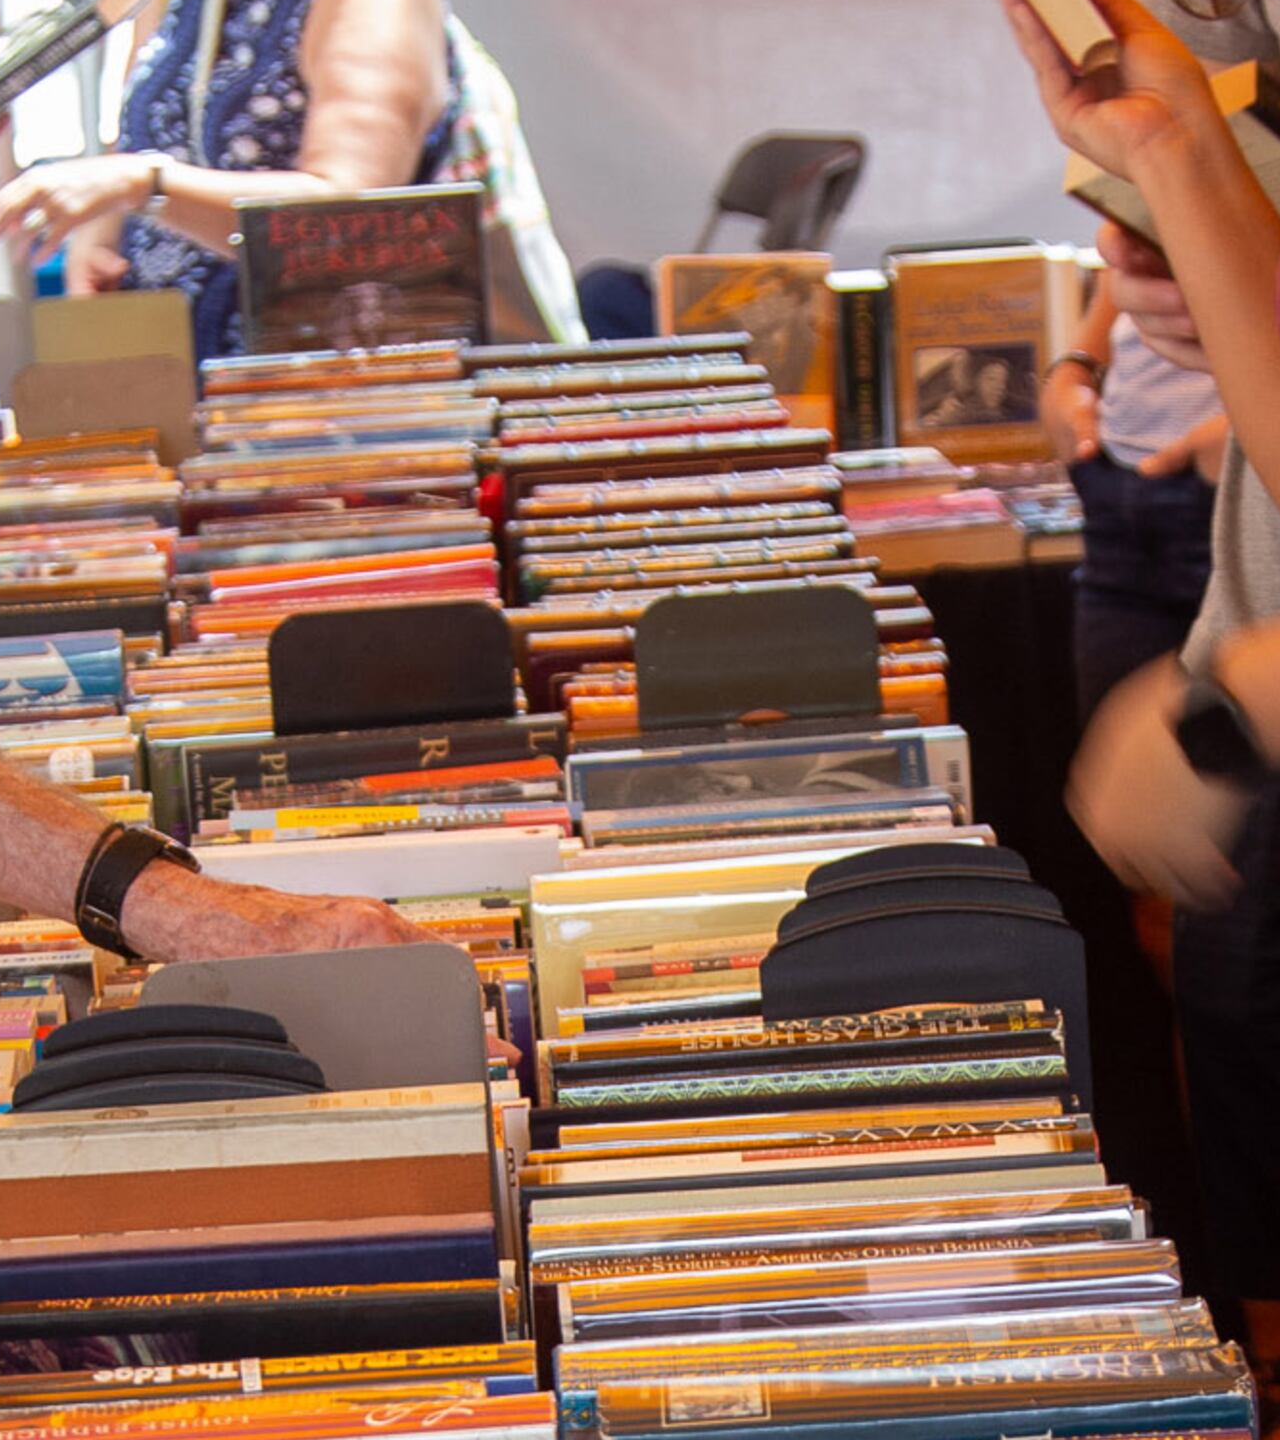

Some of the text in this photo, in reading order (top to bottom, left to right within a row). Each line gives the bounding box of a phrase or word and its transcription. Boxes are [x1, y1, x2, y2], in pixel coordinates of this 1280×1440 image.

[803, 1021, 911, 1043] GLASS
[919, 1017, 990, 1036] THE
[680, 1027, 797, 1051] HOUSE
[92, 1361, 240, 1385] The Edge
